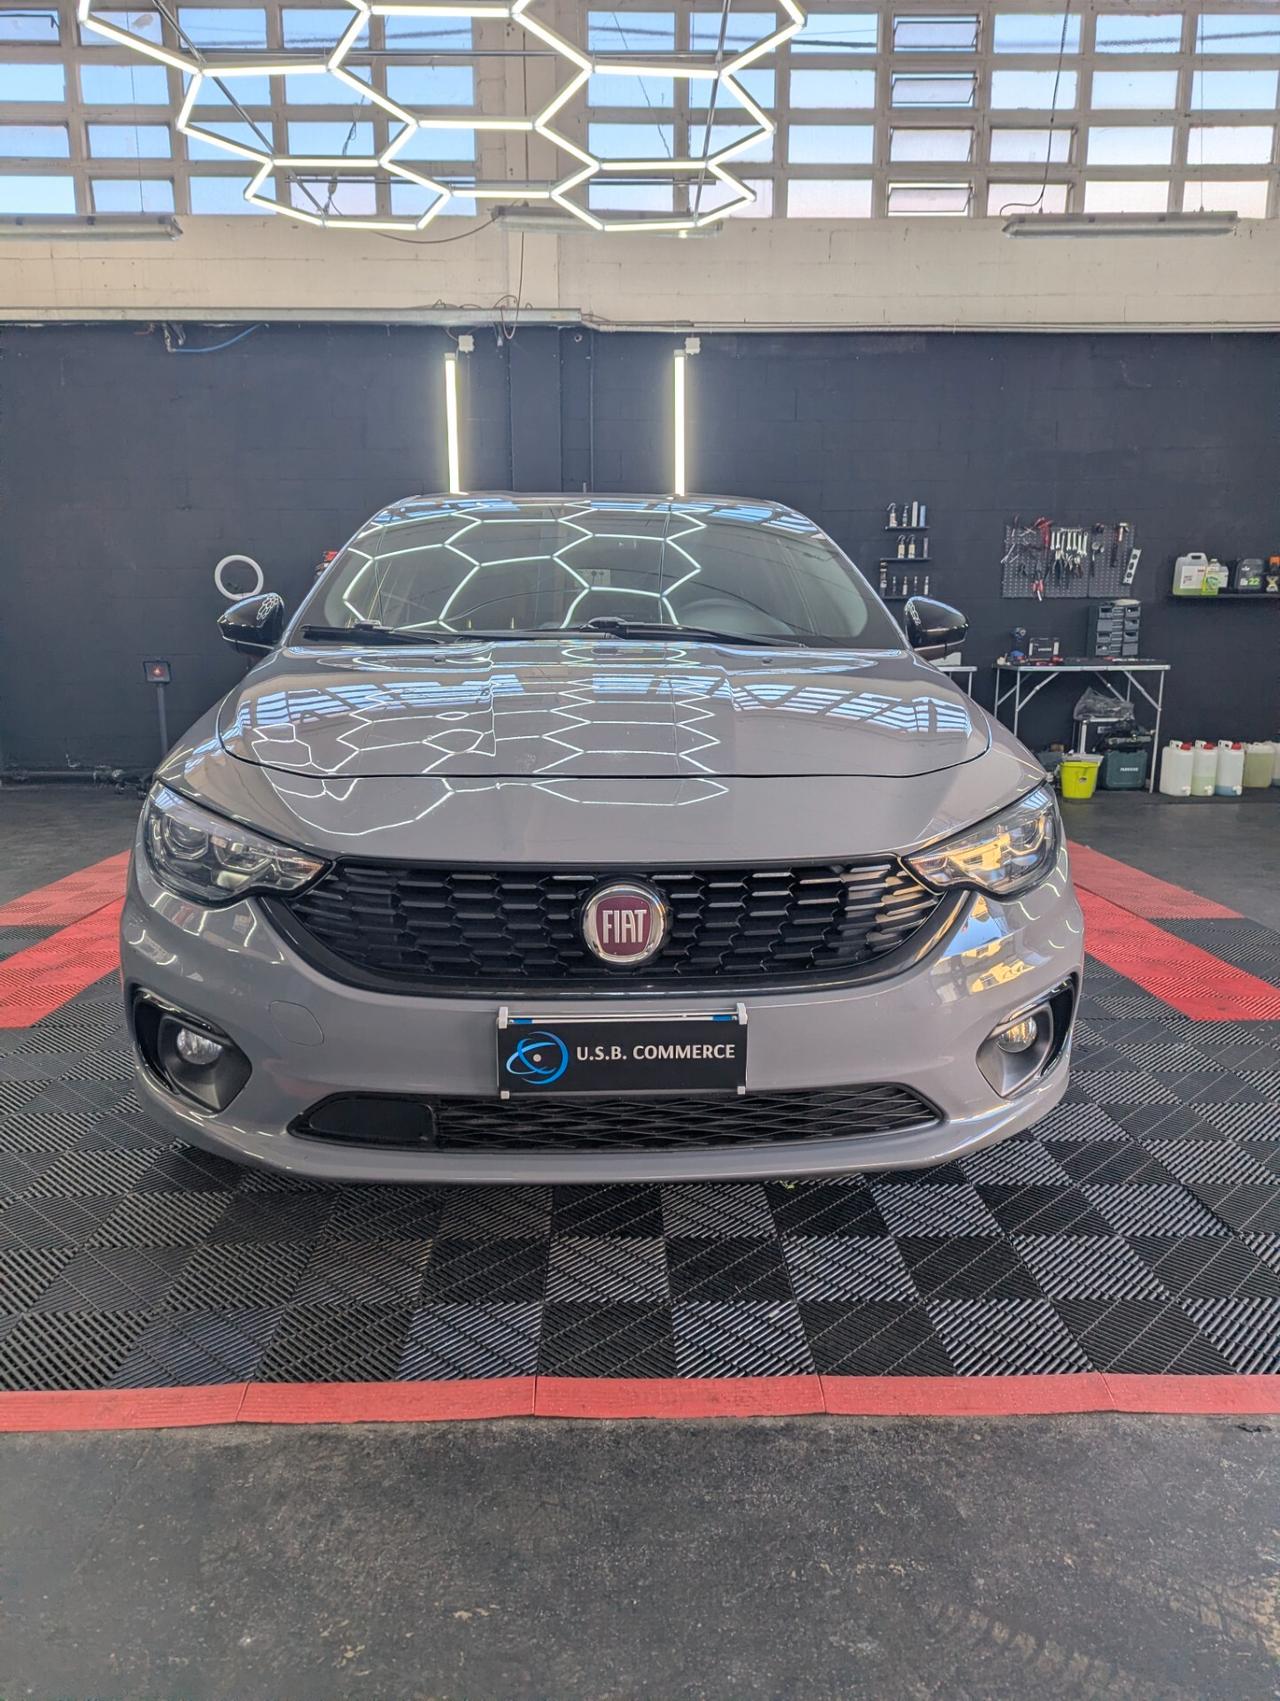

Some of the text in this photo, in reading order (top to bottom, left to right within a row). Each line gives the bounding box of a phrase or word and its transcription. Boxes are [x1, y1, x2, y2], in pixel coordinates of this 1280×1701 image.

[602, 909, 647, 943] FIAT
[576, 1044, 735, 1060] U.S.B. COMMERCE
